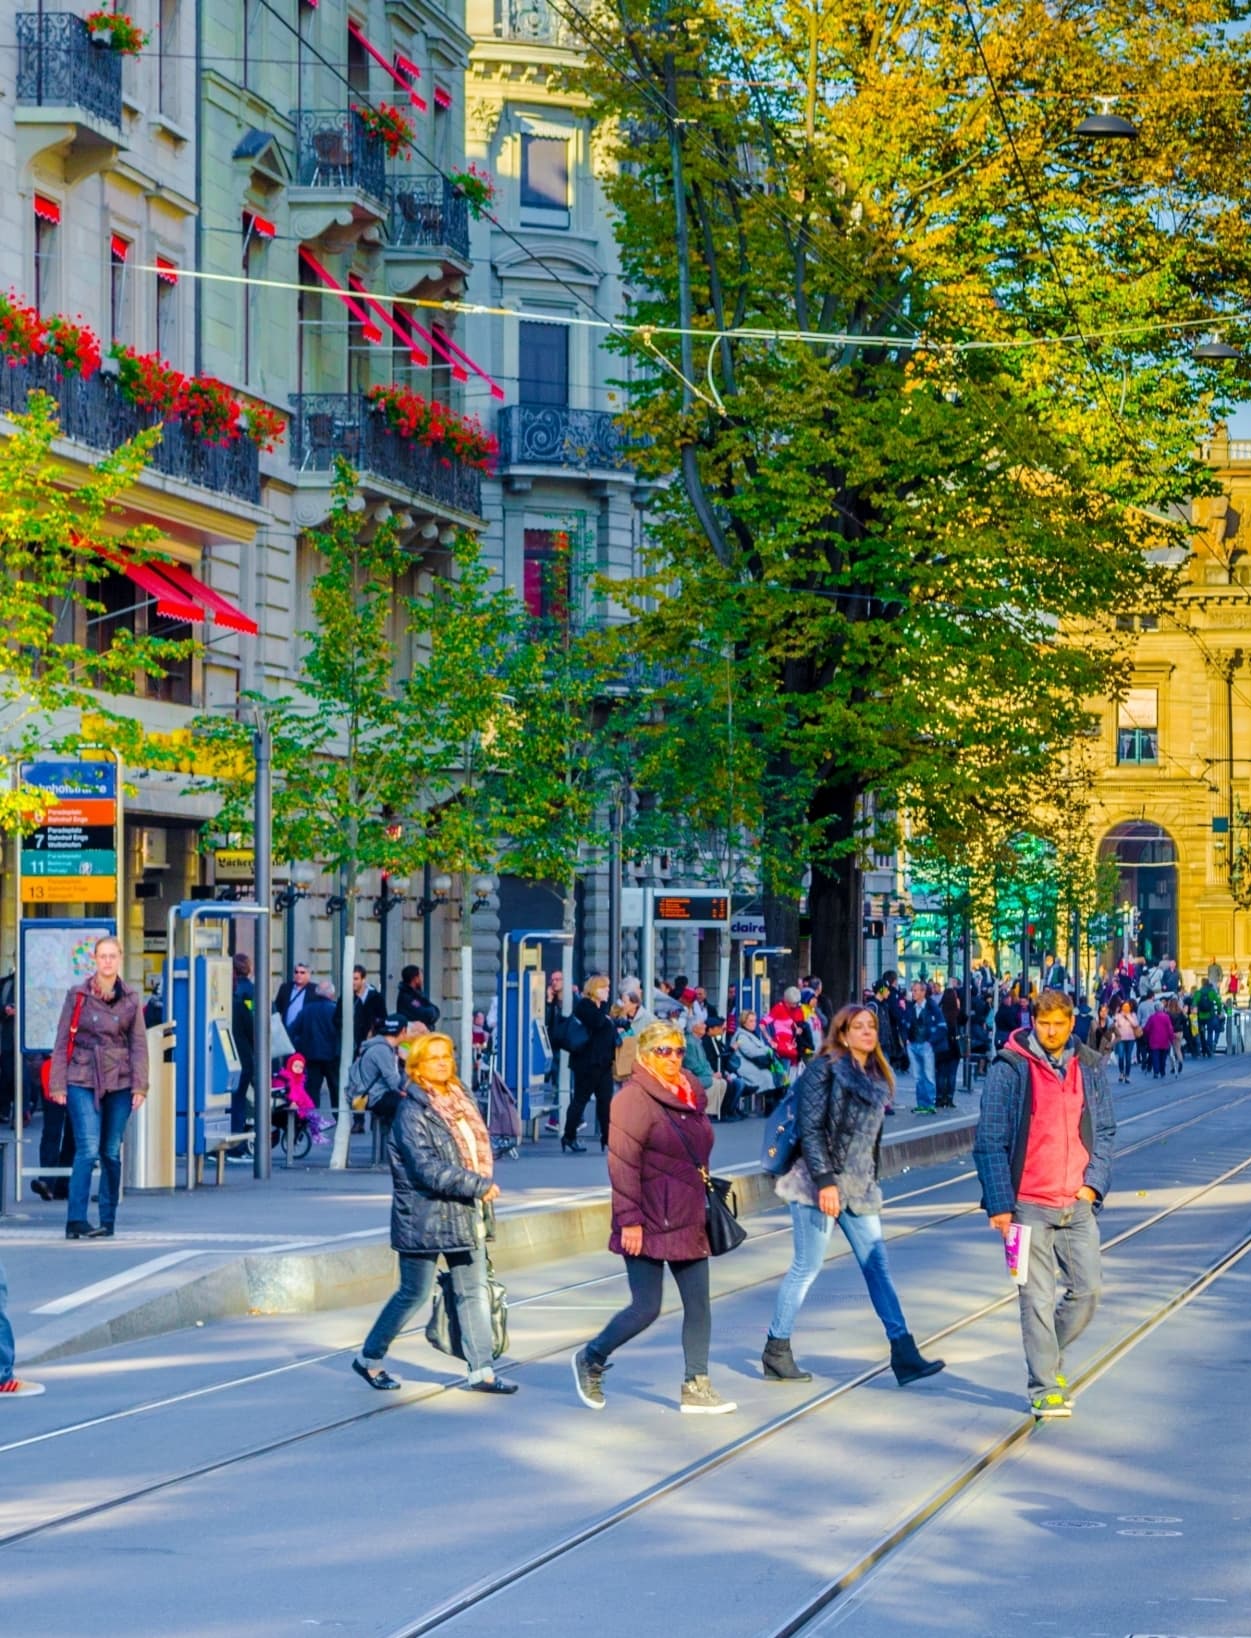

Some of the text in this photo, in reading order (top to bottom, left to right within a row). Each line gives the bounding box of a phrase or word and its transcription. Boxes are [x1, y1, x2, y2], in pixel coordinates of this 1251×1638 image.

[34, 835, 45, 849] 7
[30, 860, 45, 874] 11
[29, 886, 45, 900] 13
